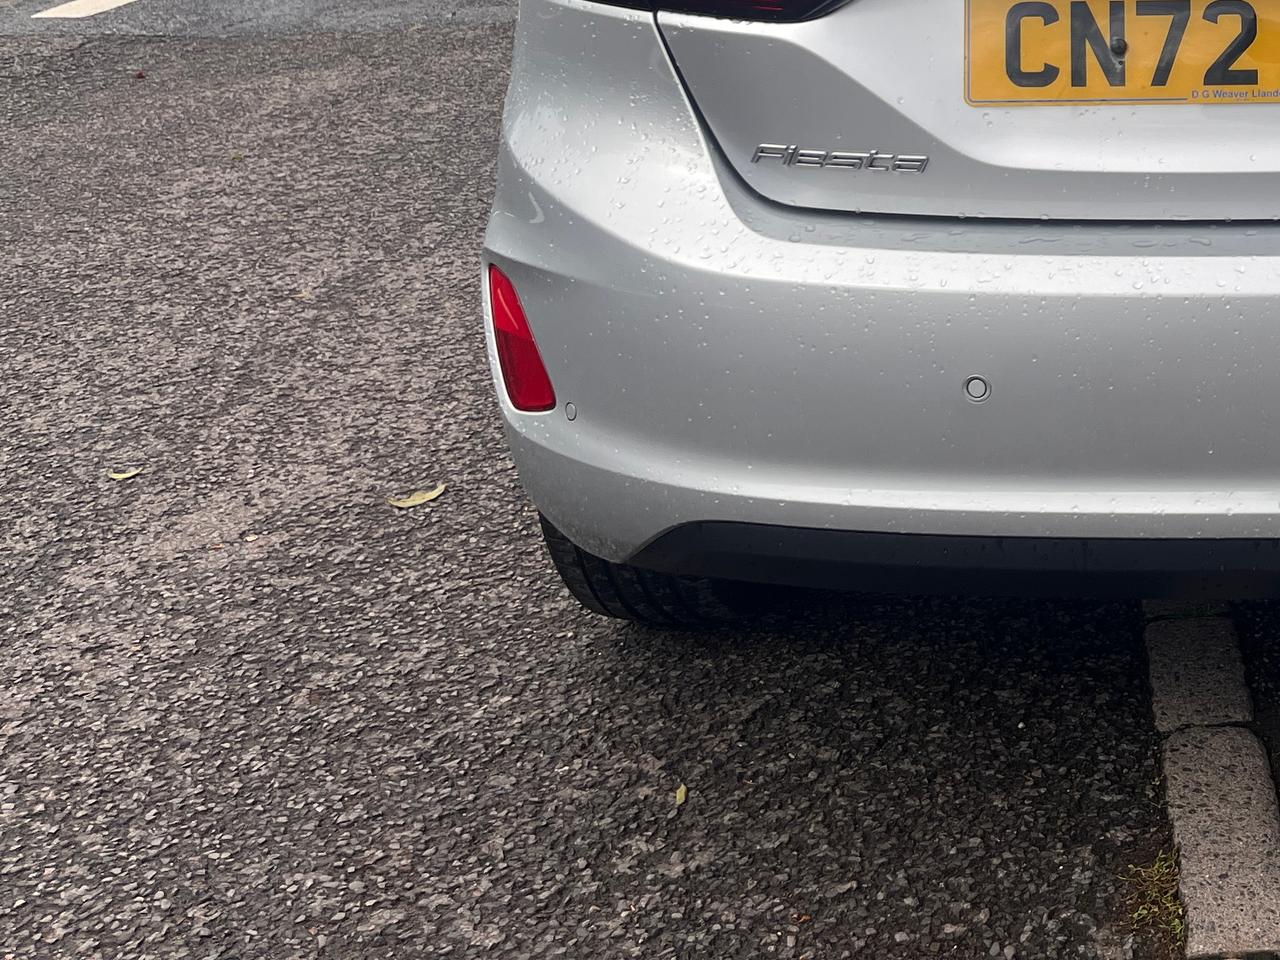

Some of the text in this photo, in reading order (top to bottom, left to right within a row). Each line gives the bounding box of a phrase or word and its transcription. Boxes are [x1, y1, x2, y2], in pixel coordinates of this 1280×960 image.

[1202, 90, 1210, 98] G
[1213, 89, 1249, 98] Weaver
[751, 143, 930, 173] Fiesta
